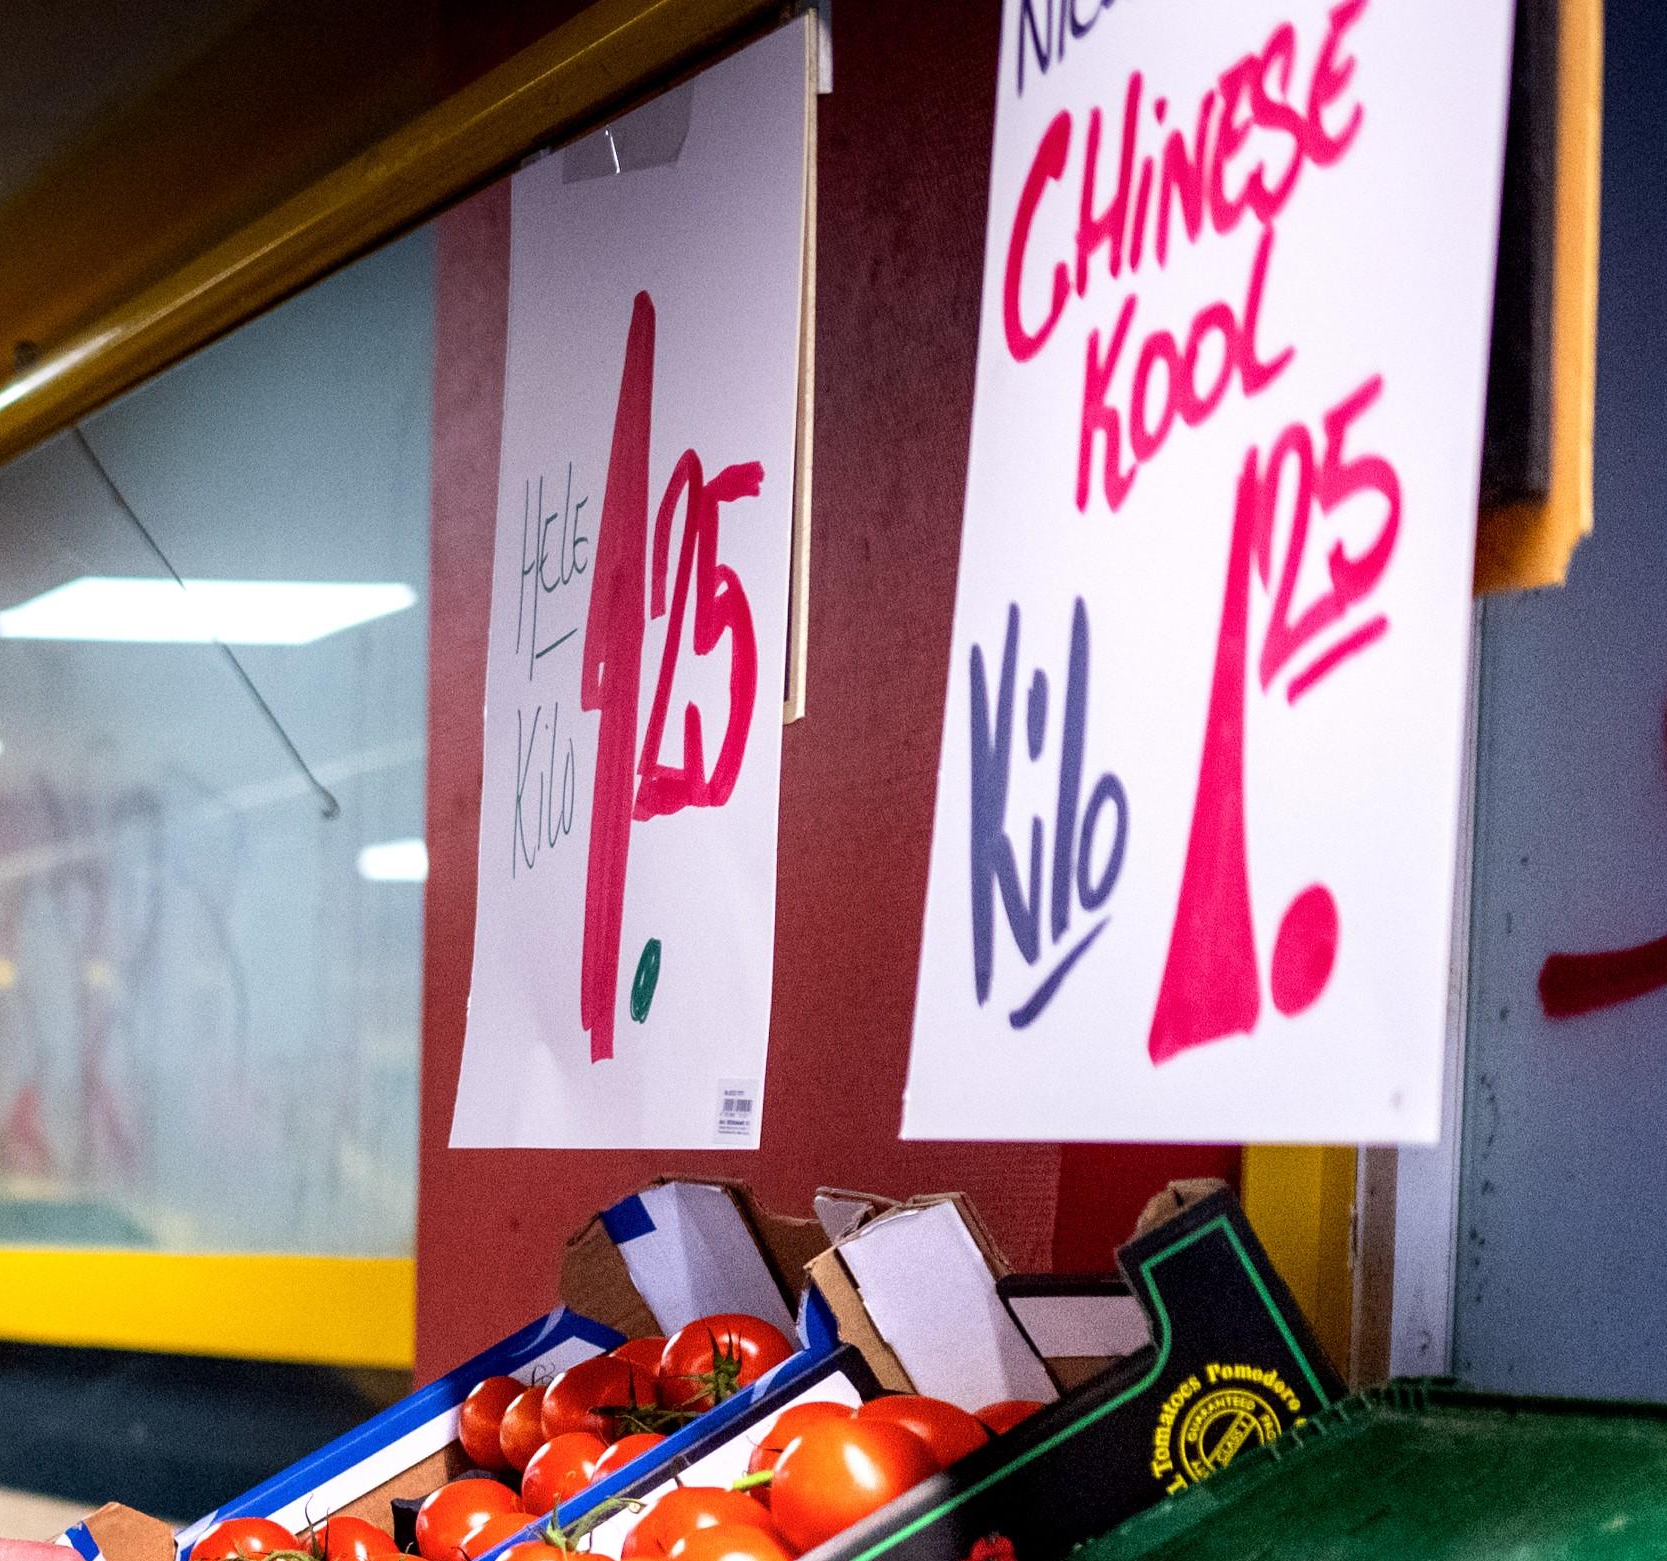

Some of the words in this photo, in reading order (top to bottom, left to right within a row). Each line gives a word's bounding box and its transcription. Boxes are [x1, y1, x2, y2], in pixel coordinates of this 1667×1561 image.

[1075, 224, 1295, 514] KOOL
[970, 595, 1128, 1007] Kilo
[1151, 1375, 1202, 1480] Tomatoes
